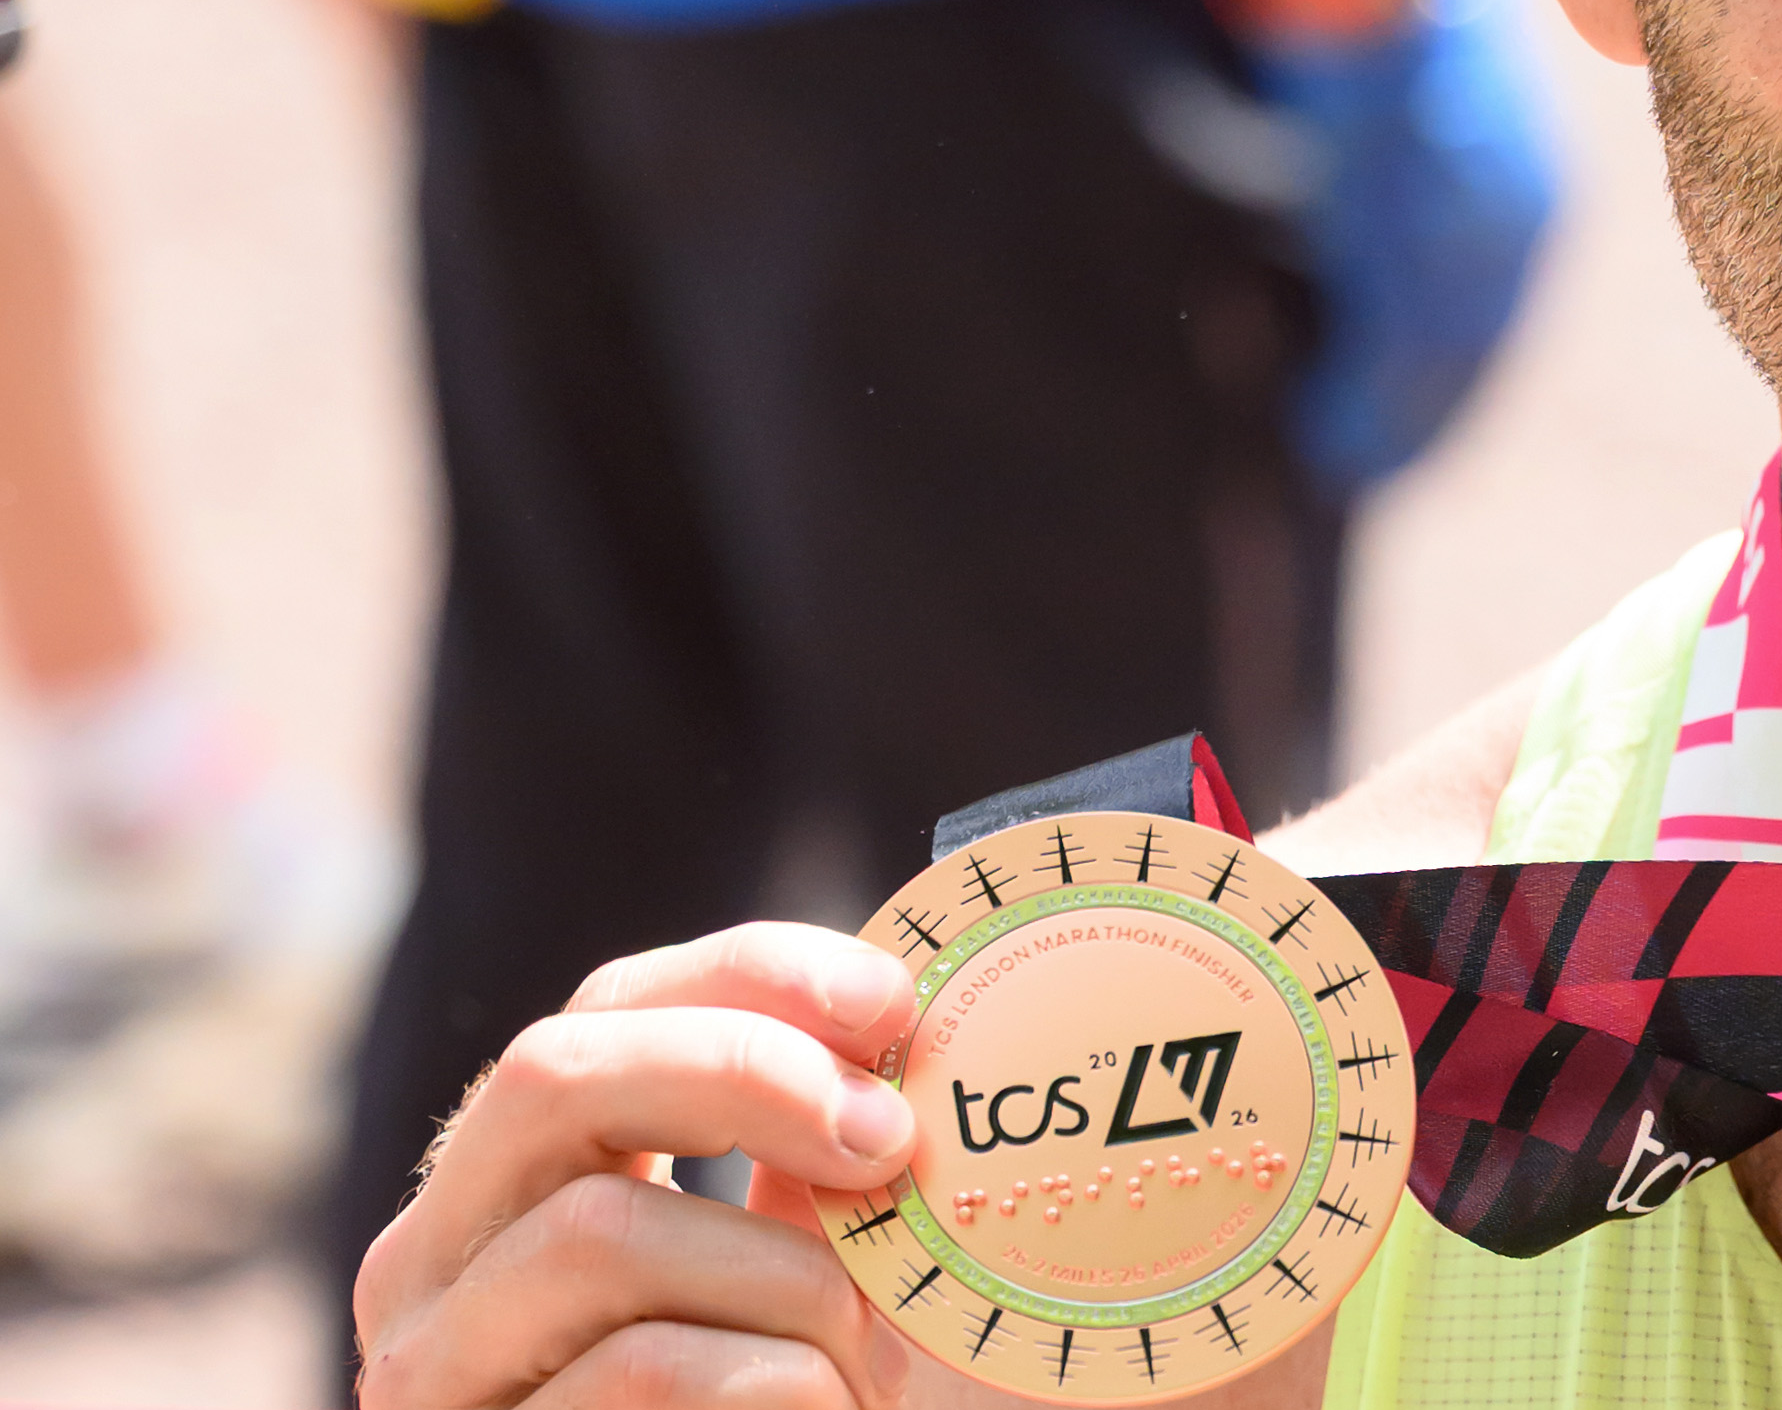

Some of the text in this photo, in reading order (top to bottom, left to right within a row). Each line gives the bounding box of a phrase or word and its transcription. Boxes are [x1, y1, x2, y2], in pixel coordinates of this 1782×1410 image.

[1033, 887, 1165, 914] BLACKHEATH
[926, 925, 1256, 1060] TCS LONDON MARATHON FINISHER
[952, 1069, 1090, 1154] tcs
[1088, 1051, 1118, 1070] 20
[1230, 1108, 1259, 1127] 26
[1150, 1241, 1214, 1281] APRIL
[1208, 1200, 1258, 1250] 2026
